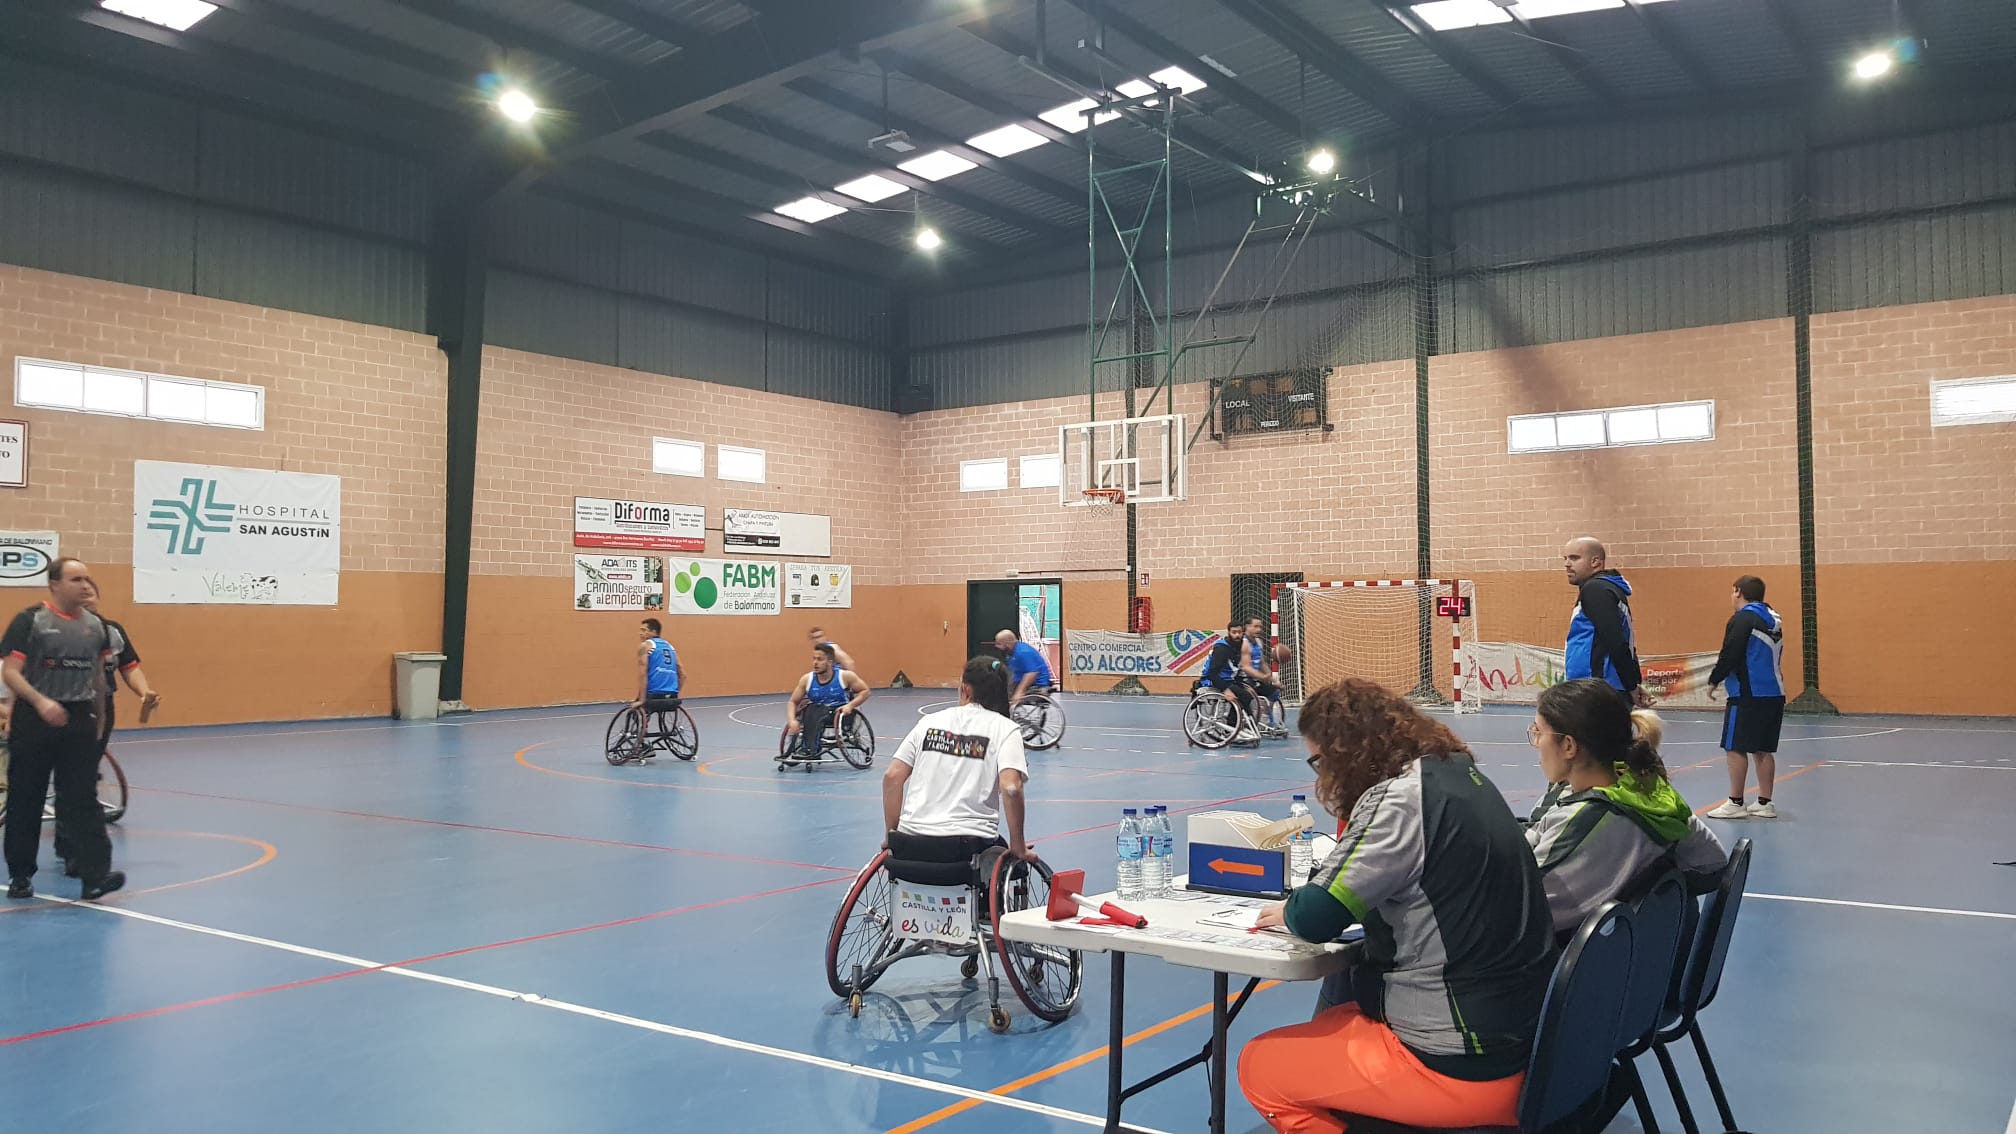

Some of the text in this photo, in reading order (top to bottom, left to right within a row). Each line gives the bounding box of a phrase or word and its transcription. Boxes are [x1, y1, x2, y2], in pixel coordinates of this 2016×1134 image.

[1225, 400, 1250, 409] LOCAL
[239, 504, 330, 520] HOSPITAL
[615, 502, 670, 522] Diforma
[239, 524, 267, 536] SAN
[723, 563, 776, 589] FABM
[723, 600, 776, 611] de Balonmano
[1439, 597, 1461, 615] 24
[1069, 642, 1146, 653] CENTRO COMERCIAL
[1070, 654, 1162, 672] LOS ALCORES
[1463, 654, 1565, 692] Andalu
[926, 734, 955, 746] CASTILLA
[902, 901, 937, 912] CASTILLA
[946, 906, 967, 914] LEÓN
[902, 915, 965, 938] es vida
